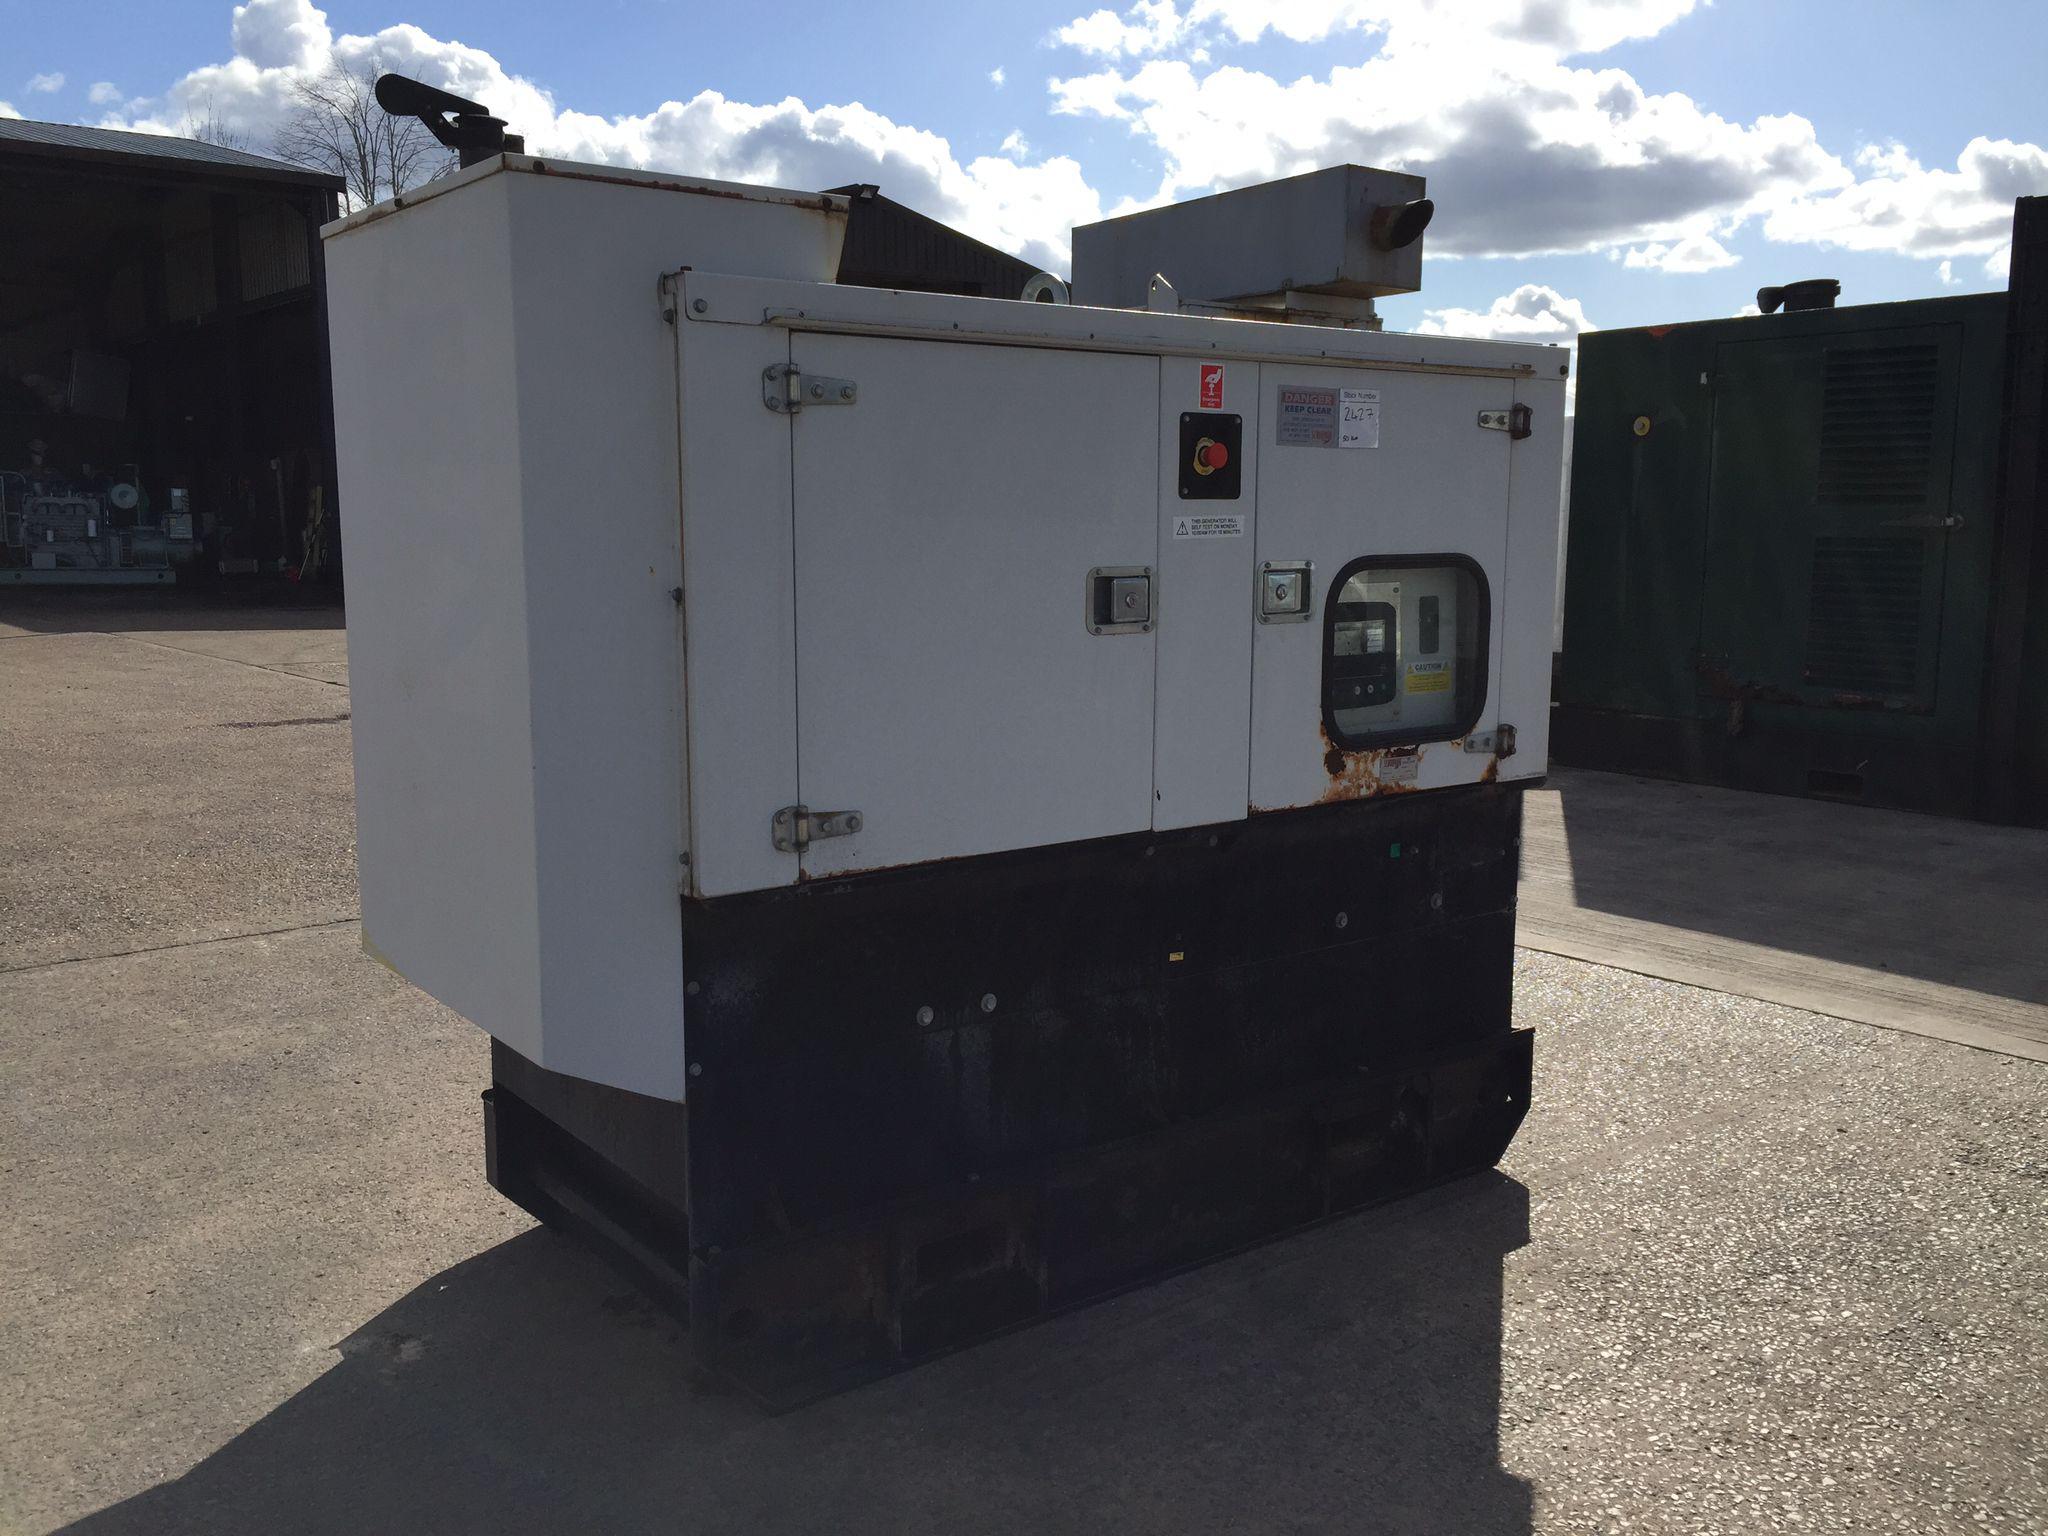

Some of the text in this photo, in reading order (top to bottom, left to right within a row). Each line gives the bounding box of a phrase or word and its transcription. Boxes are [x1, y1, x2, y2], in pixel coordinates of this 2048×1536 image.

[1285, 393, 1333, 405] DANGER
[1285, 405, 1332, 415] KEEP CLEAR
[1344, 406, 1374, 421] 2427
[1415, 663, 1442, 672] CAUTION
